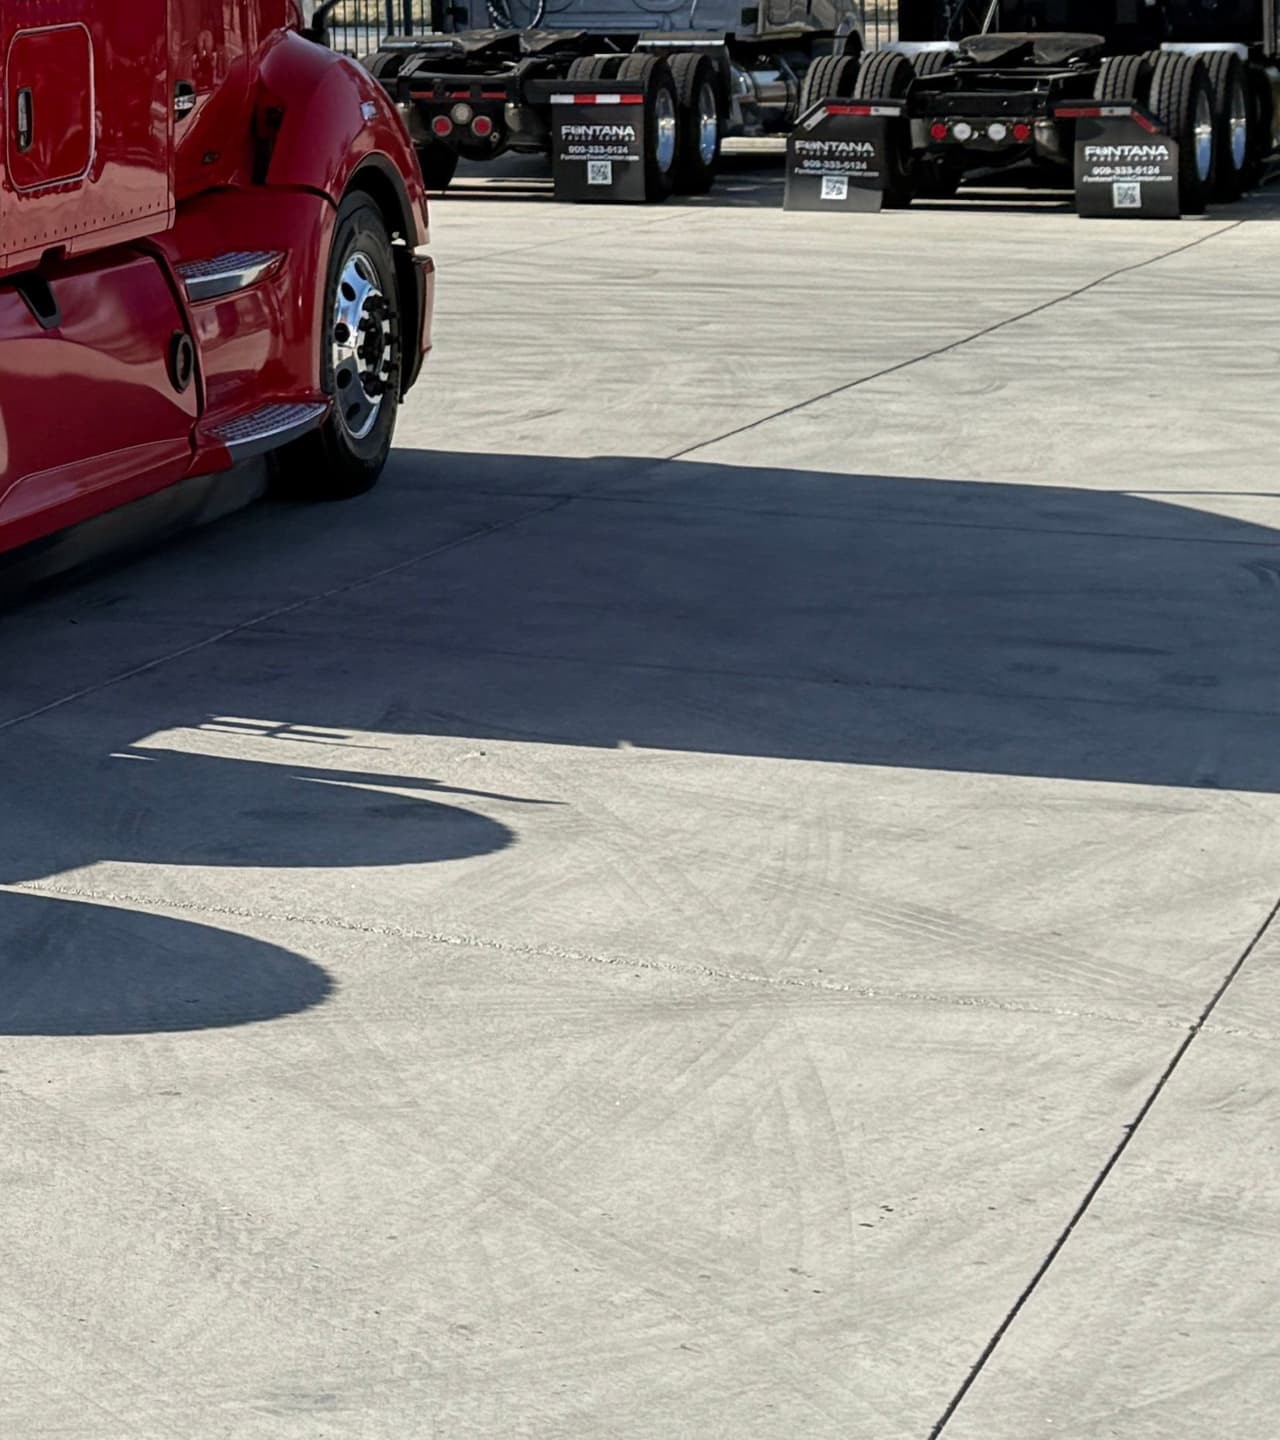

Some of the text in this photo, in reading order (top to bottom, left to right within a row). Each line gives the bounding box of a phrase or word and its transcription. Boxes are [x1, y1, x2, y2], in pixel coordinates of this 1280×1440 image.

[561, 125, 635, 136] FONTANA
[795, 140, 874, 152] FONTANA
[1084, 145, 1169, 156] FONTANA
